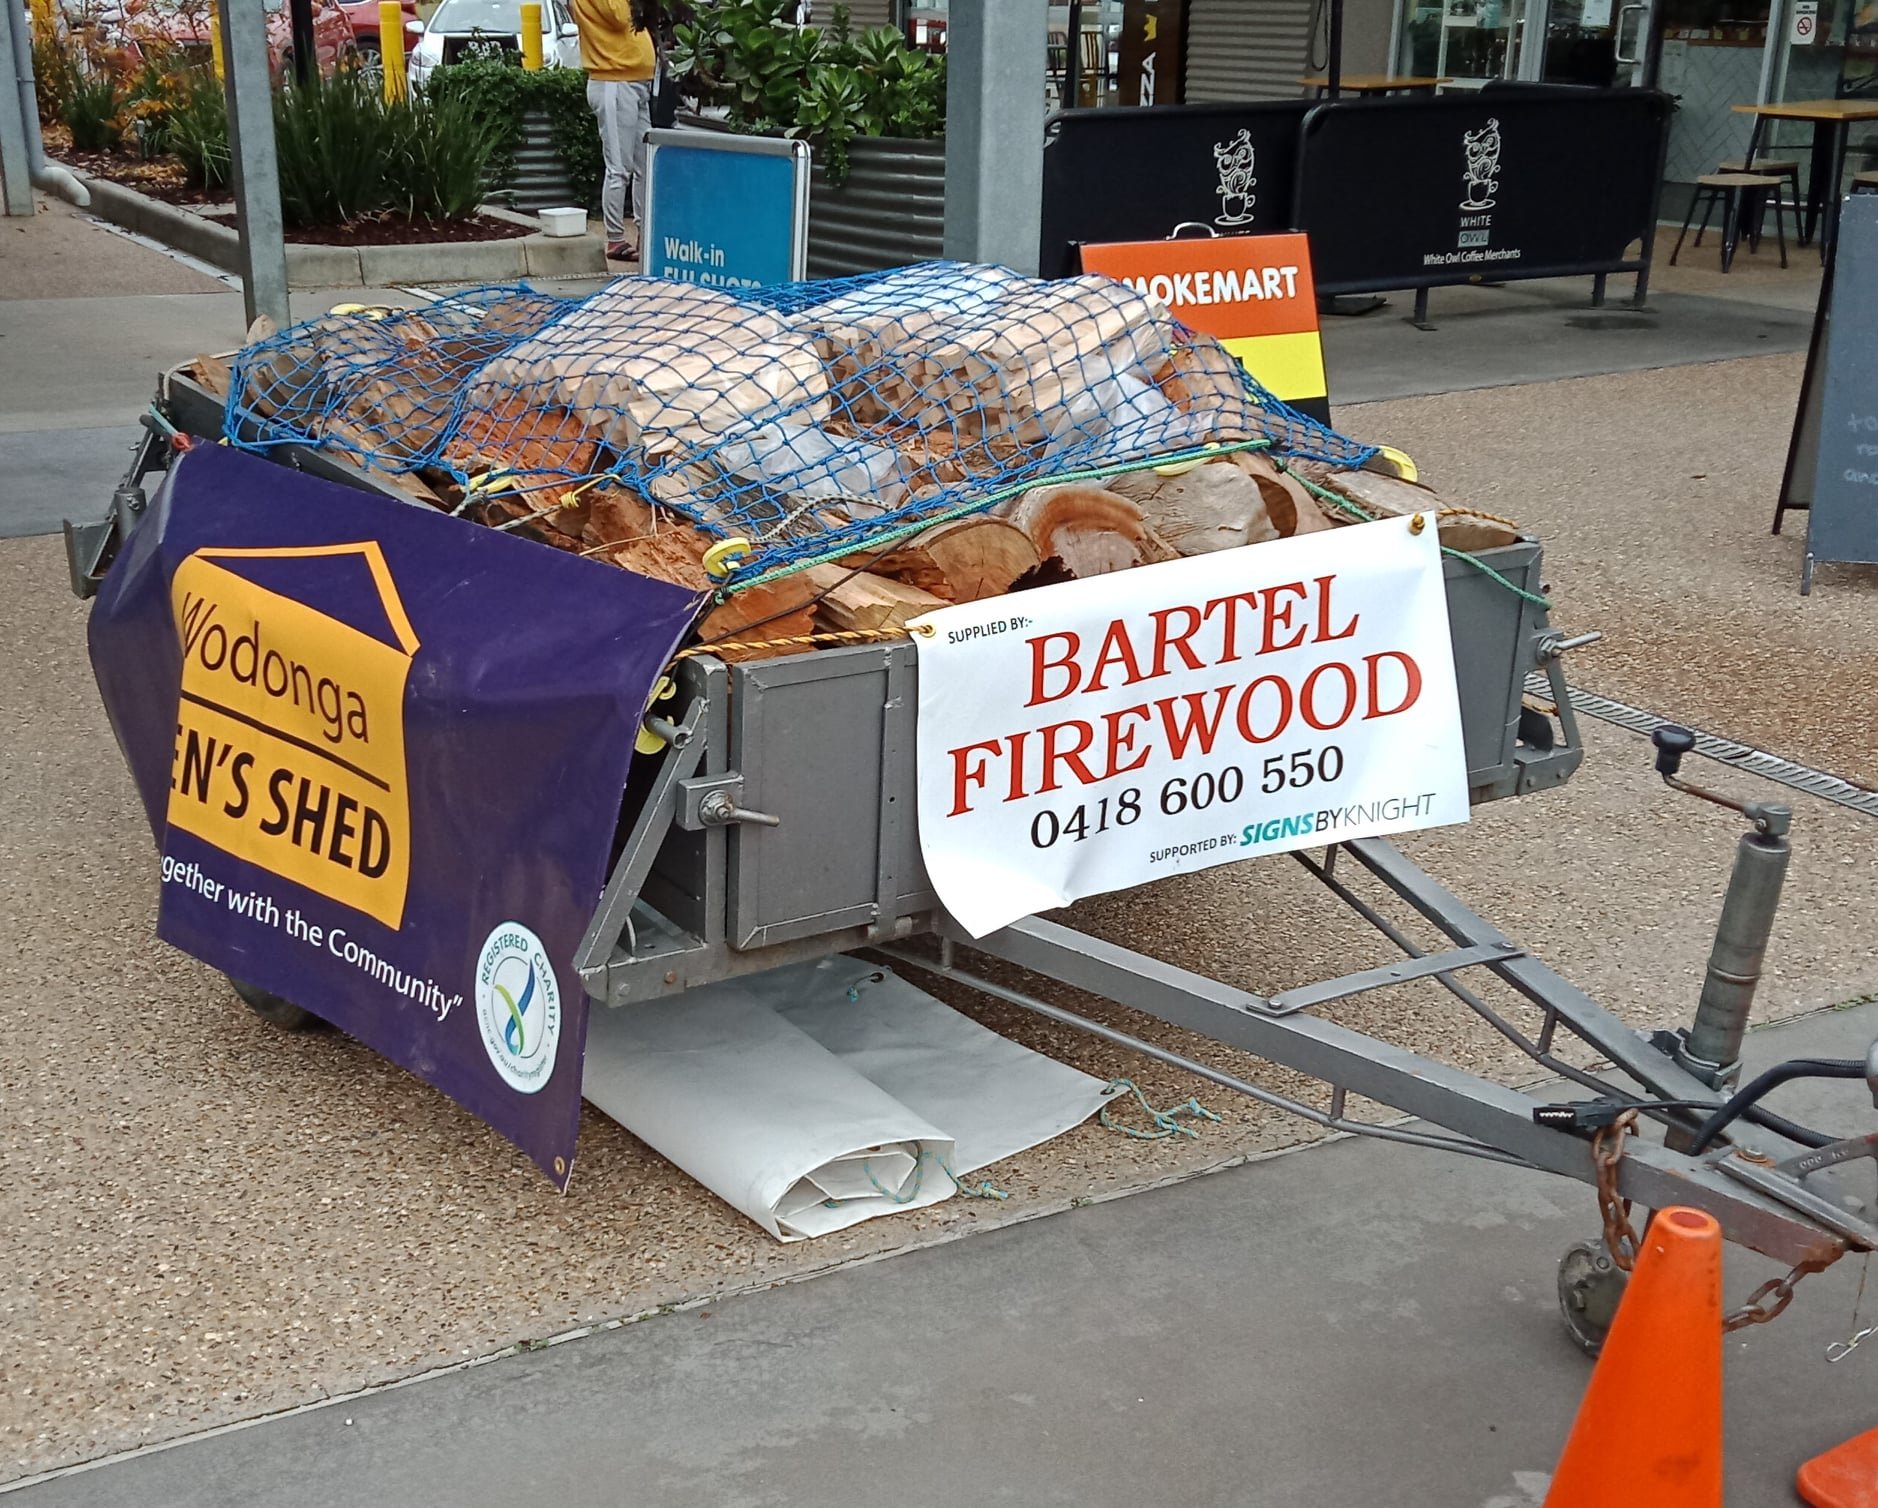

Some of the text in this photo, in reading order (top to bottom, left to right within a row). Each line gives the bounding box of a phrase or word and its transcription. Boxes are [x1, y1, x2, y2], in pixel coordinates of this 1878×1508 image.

[664, 237, 724, 268] Walk-in
[1459, 231, 1488, 244] OWL
[1460, 215, 1492, 227] WHITE
[1110, 266, 1298, 306] MOKEMART
[1424, 248, 1520, 265] White Owl Coffee Merchants
[948, 620, 1007, 645] SUPPLIED
[1023, 574, 1360, 708] BARTEL
[182, 591, 369, 744] Wodonga
[946, 651, 1423, 818] FIREWOOD
[259, 768, 391, 879] SHED
[1031, 745, 1344, 849] 0418 600 550
[1149, 837, 1218, 864] SUPPORTED
[1219, 833, 1237, 847] BY:
[161, 855, 225, 903] gether
[227, 891, 281, 929] with
[285, 909, 324, 947] the
[481, 933, 557, 1036] REGISTERED CHARITY
